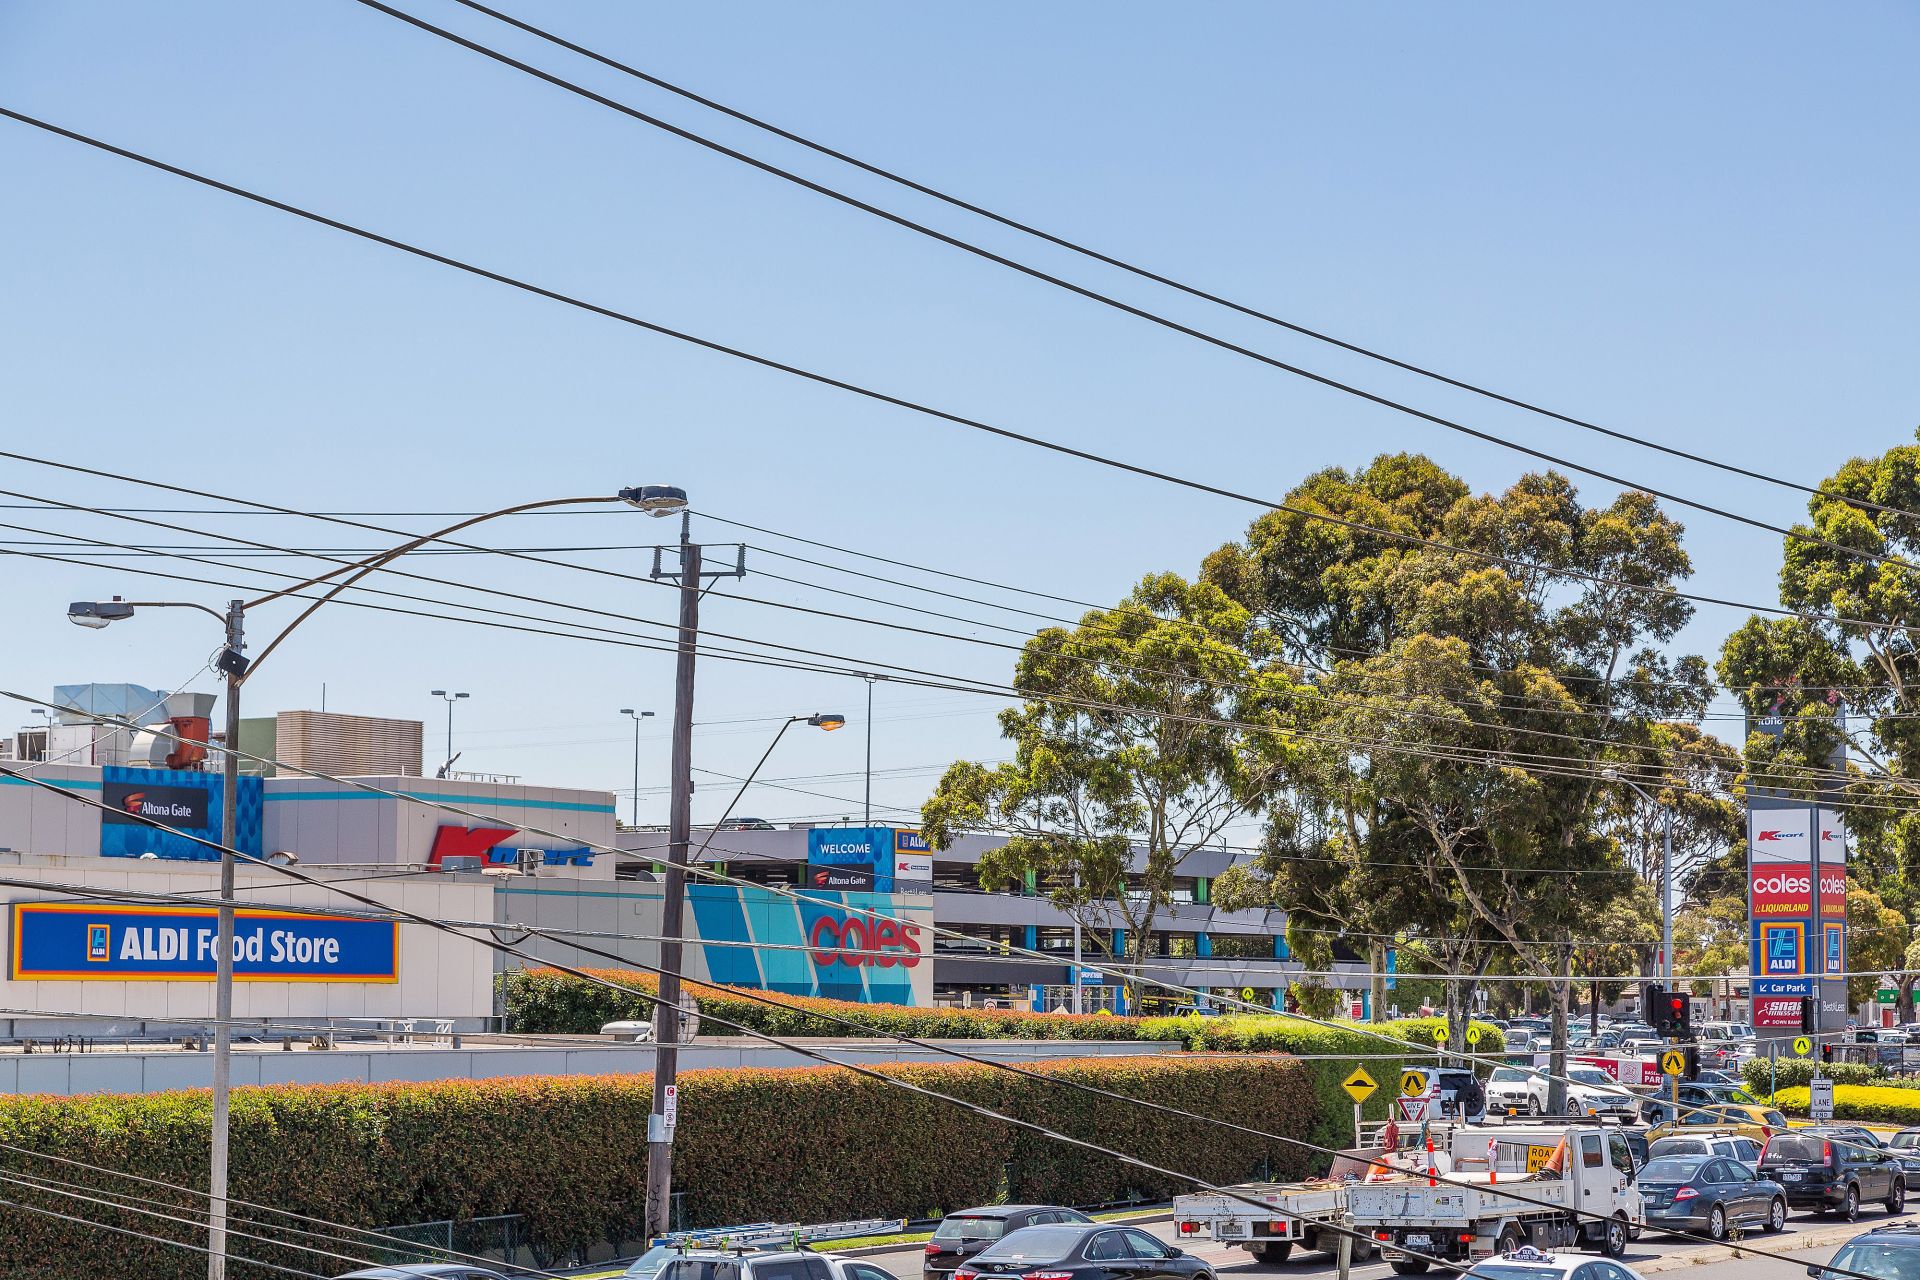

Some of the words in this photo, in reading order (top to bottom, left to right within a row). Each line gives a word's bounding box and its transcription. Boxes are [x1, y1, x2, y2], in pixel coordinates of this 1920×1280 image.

[141, 801, 170, 816] Altona
[171, 803, 192, 817] Gate
[1758, 830, 1805, 841] Kmart
[425, 825, 597, 872] Kmrt
[820, 843, 871, 854] WELCOME
[828, 876, 850, 885] Altona
[850, 875, 866, 885] Gate
[1753, 873, 1811, 894] coles
[1820, 874, 1846, 895] coles
[1761, 903, 1809, 914] LIQUORLAND
[811, 907, 921, 968] coles
[119, 927, 189, 961] ALDI
[270, 930, 340, 964] Store
[92, 947, 106, 956] ALDI
[1770, 959, 1796, 970] ALDI
[1827, 959, 1840, 970] ALDI
[1771, 984, 1785, 992] Car
[1786, 983, 1807, 992] Park
[1813, 1098, 1830, 1107] LANE
